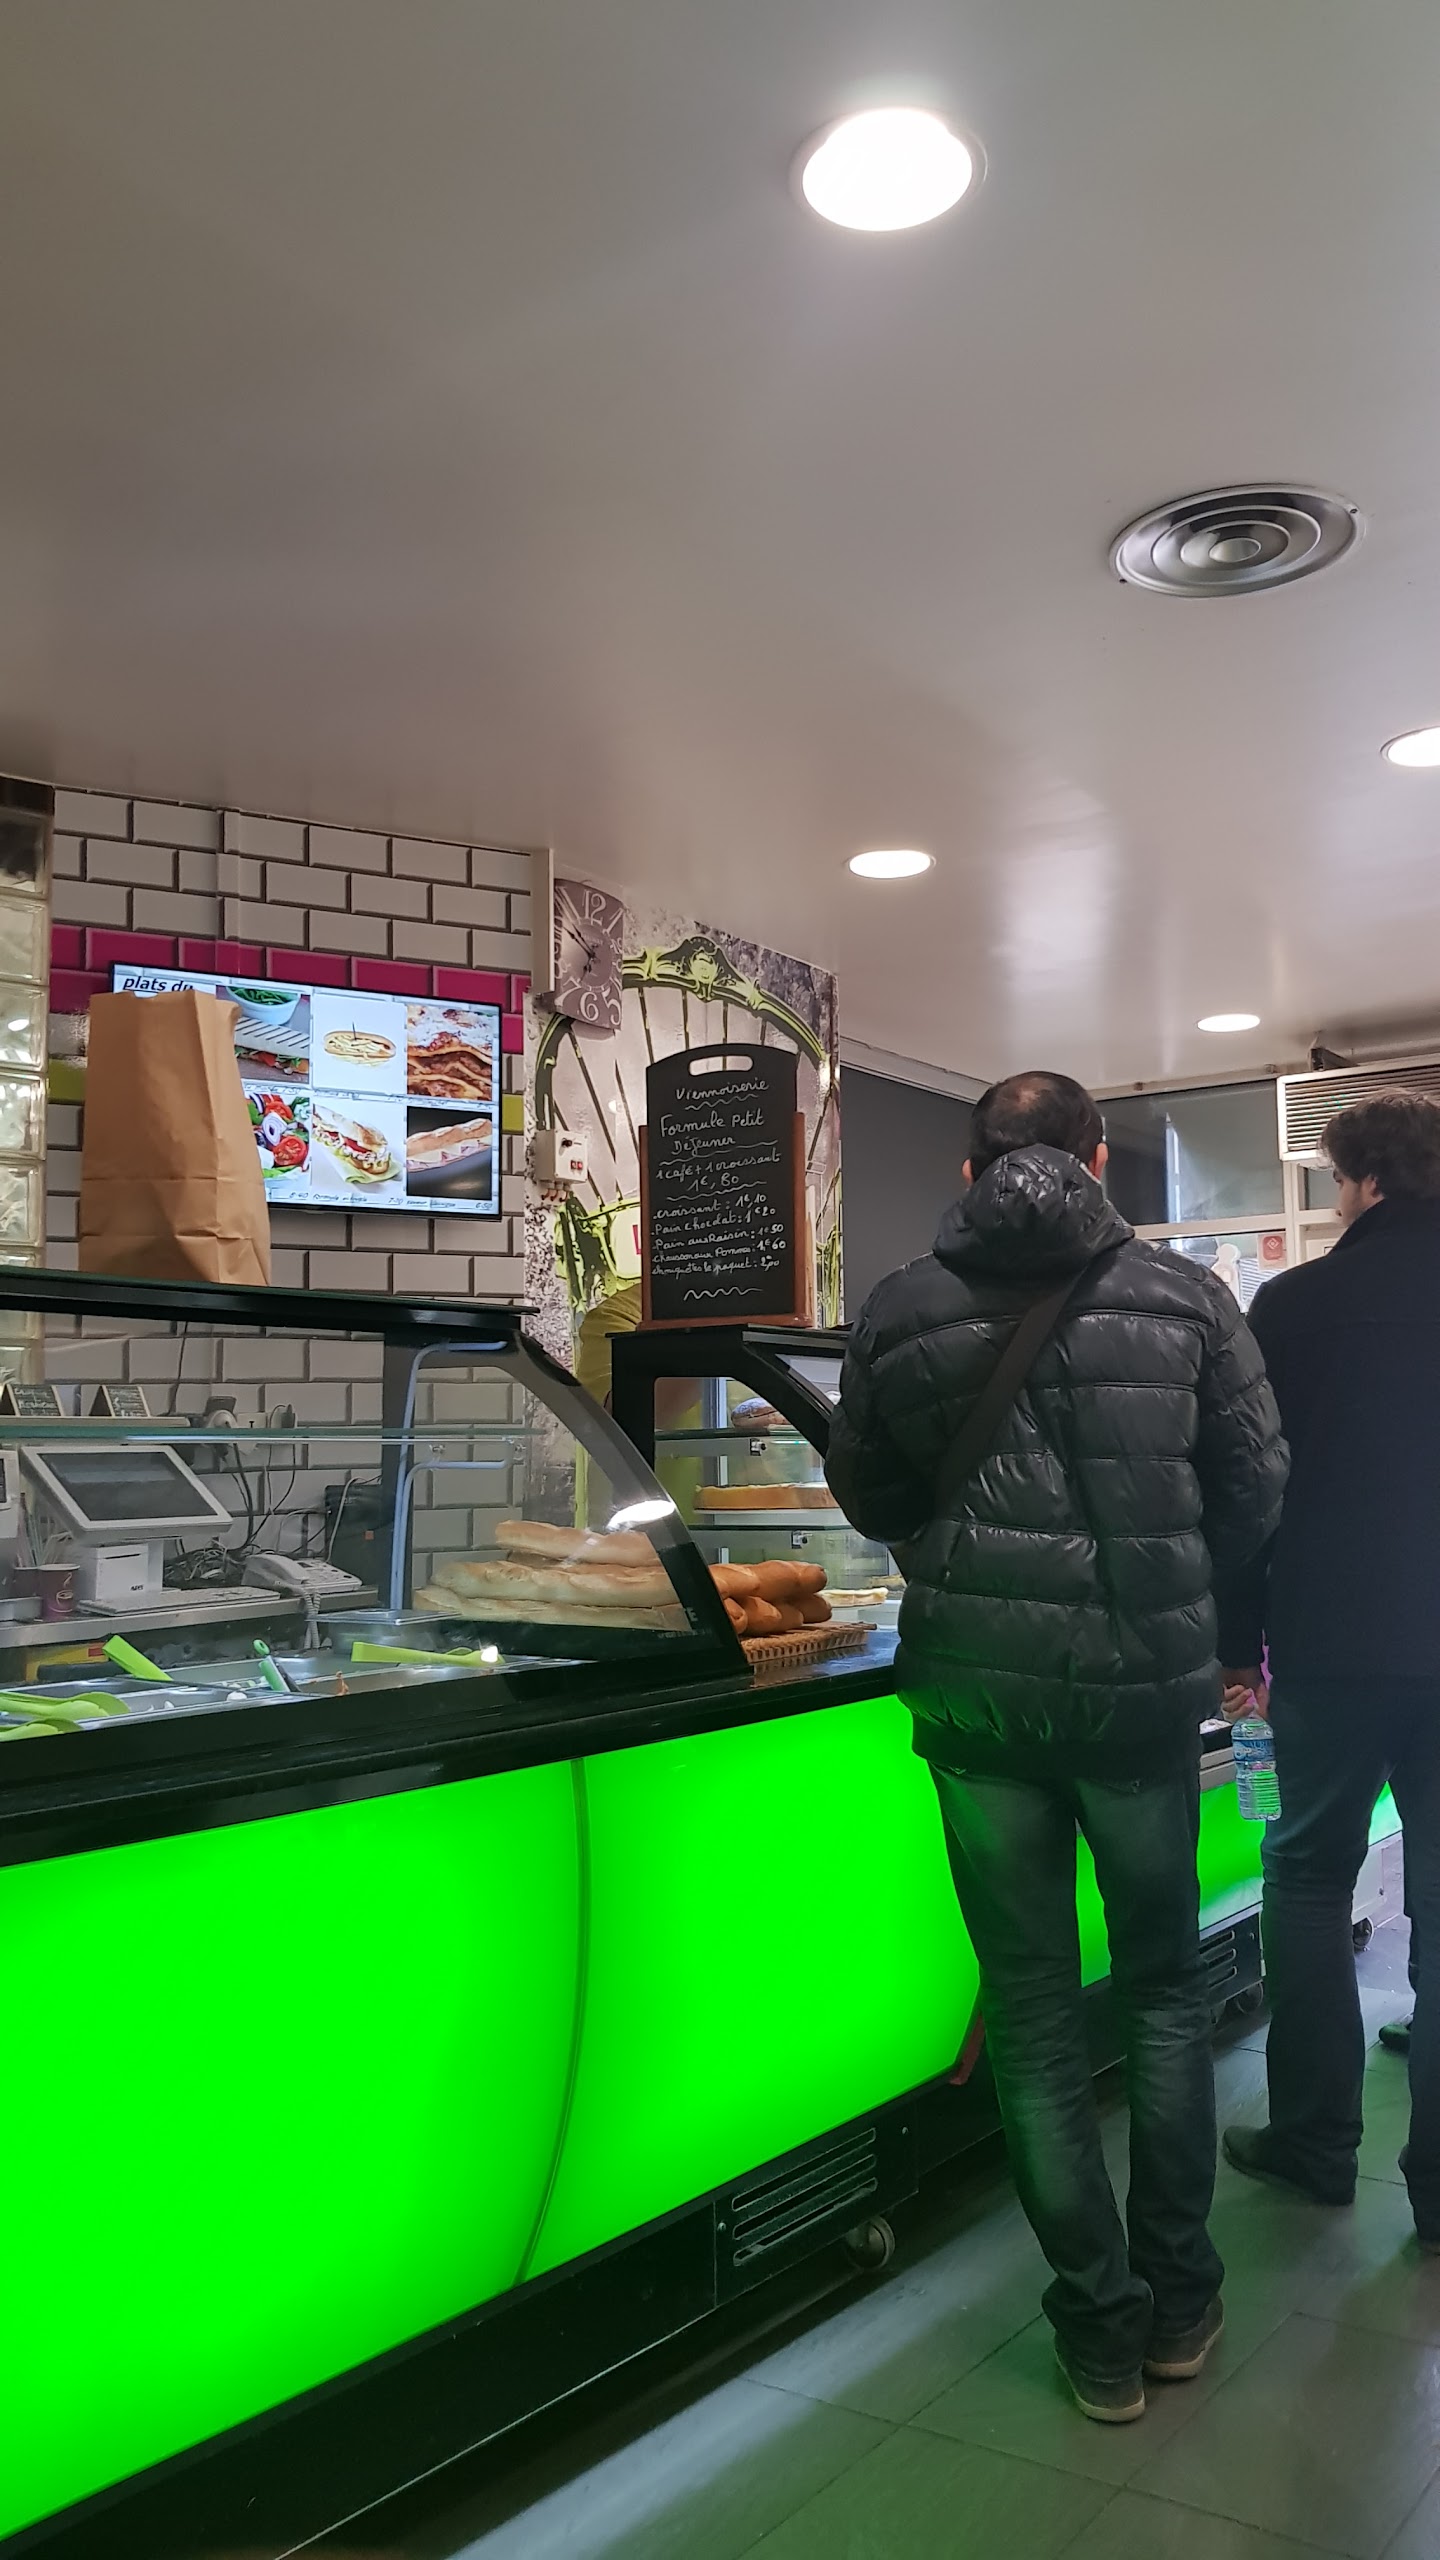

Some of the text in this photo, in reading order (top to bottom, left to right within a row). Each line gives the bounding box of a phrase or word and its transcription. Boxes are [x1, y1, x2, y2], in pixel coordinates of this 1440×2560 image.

[582, 889, 606, 926] 12
[122, 975, 167, 993] plats
[579, 991, 599, 1022] 6
[602, 986, 622, 1026] 5
[661, 1107, 765, 1138] Formule Petit
